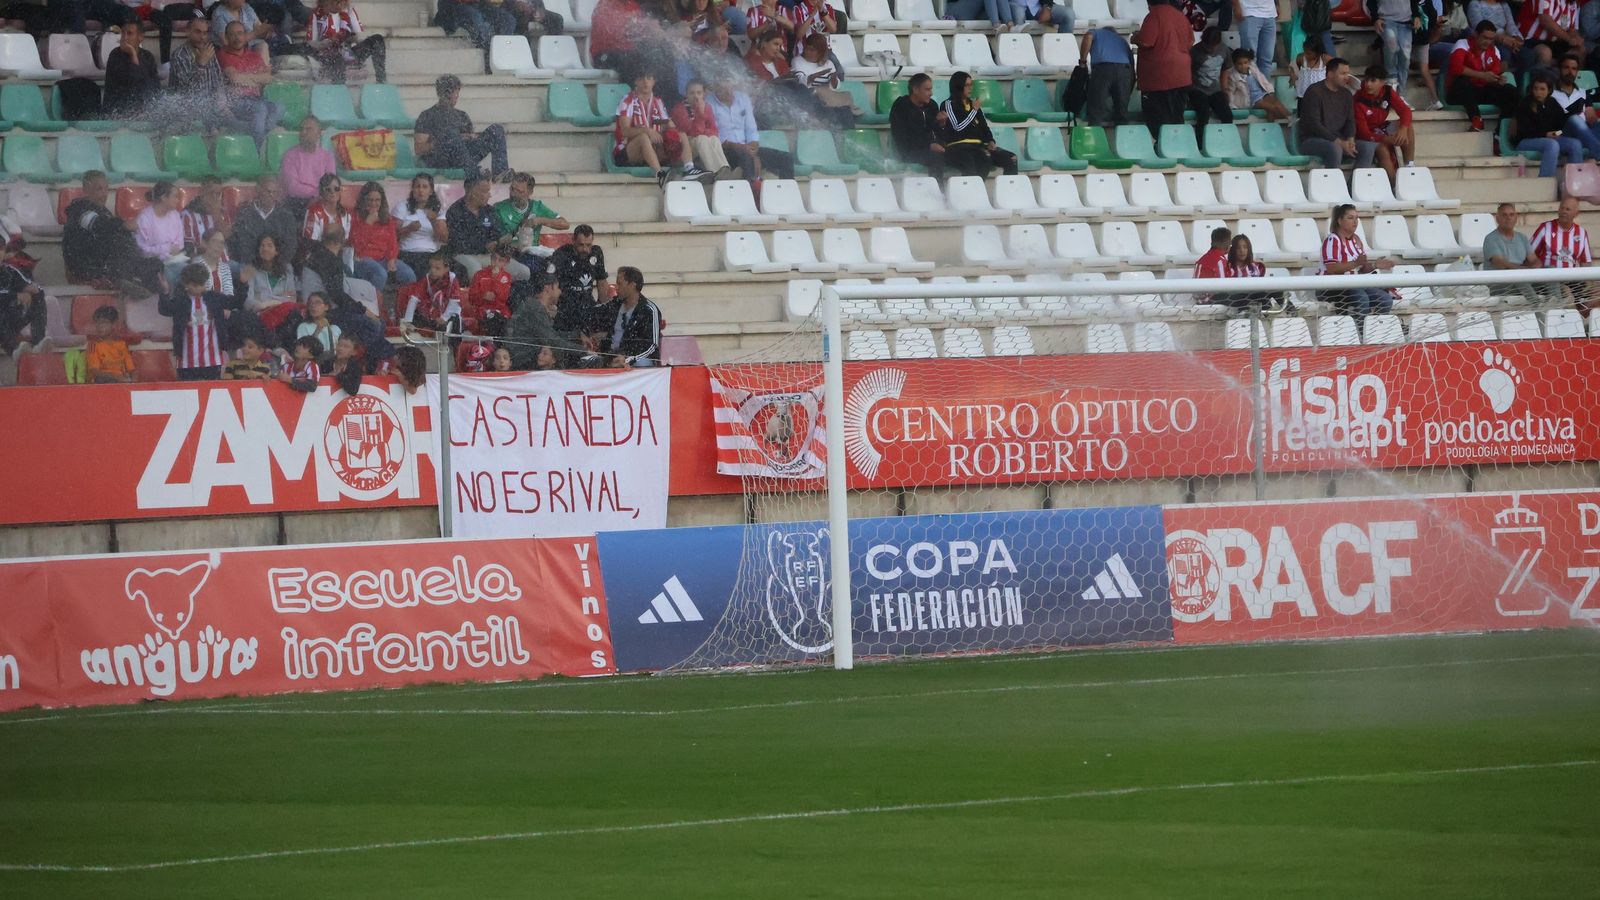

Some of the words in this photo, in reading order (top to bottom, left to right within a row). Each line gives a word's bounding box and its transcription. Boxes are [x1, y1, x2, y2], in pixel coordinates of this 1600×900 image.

[871, 402, 1039, 443] CENTRO
[1051, 389, 1198, 437] ÓPTICO
[1268, 356, 1388, 424] fisio
[448, 391, 657, 448] CASTAÑEDA
[1271, 406, 1408, 458] readapt
[1425, 409, 1577, 459] podoactiva
[947, 438, 1129, 477] ROBERTO
[1446, 443, 1500, 458] PODOLOGÍA
[456, 471, 497, 514] NO
[501, 471, 541, 514] ES
[268, 555, 521, 613] Escuela
[865, 539, 1018, 581] COPA
[1320, 520, 1419, 616] CF
[870, 582, 1023, 633] FEDERACIÓN
[281, 614, 530, 680] infantil
